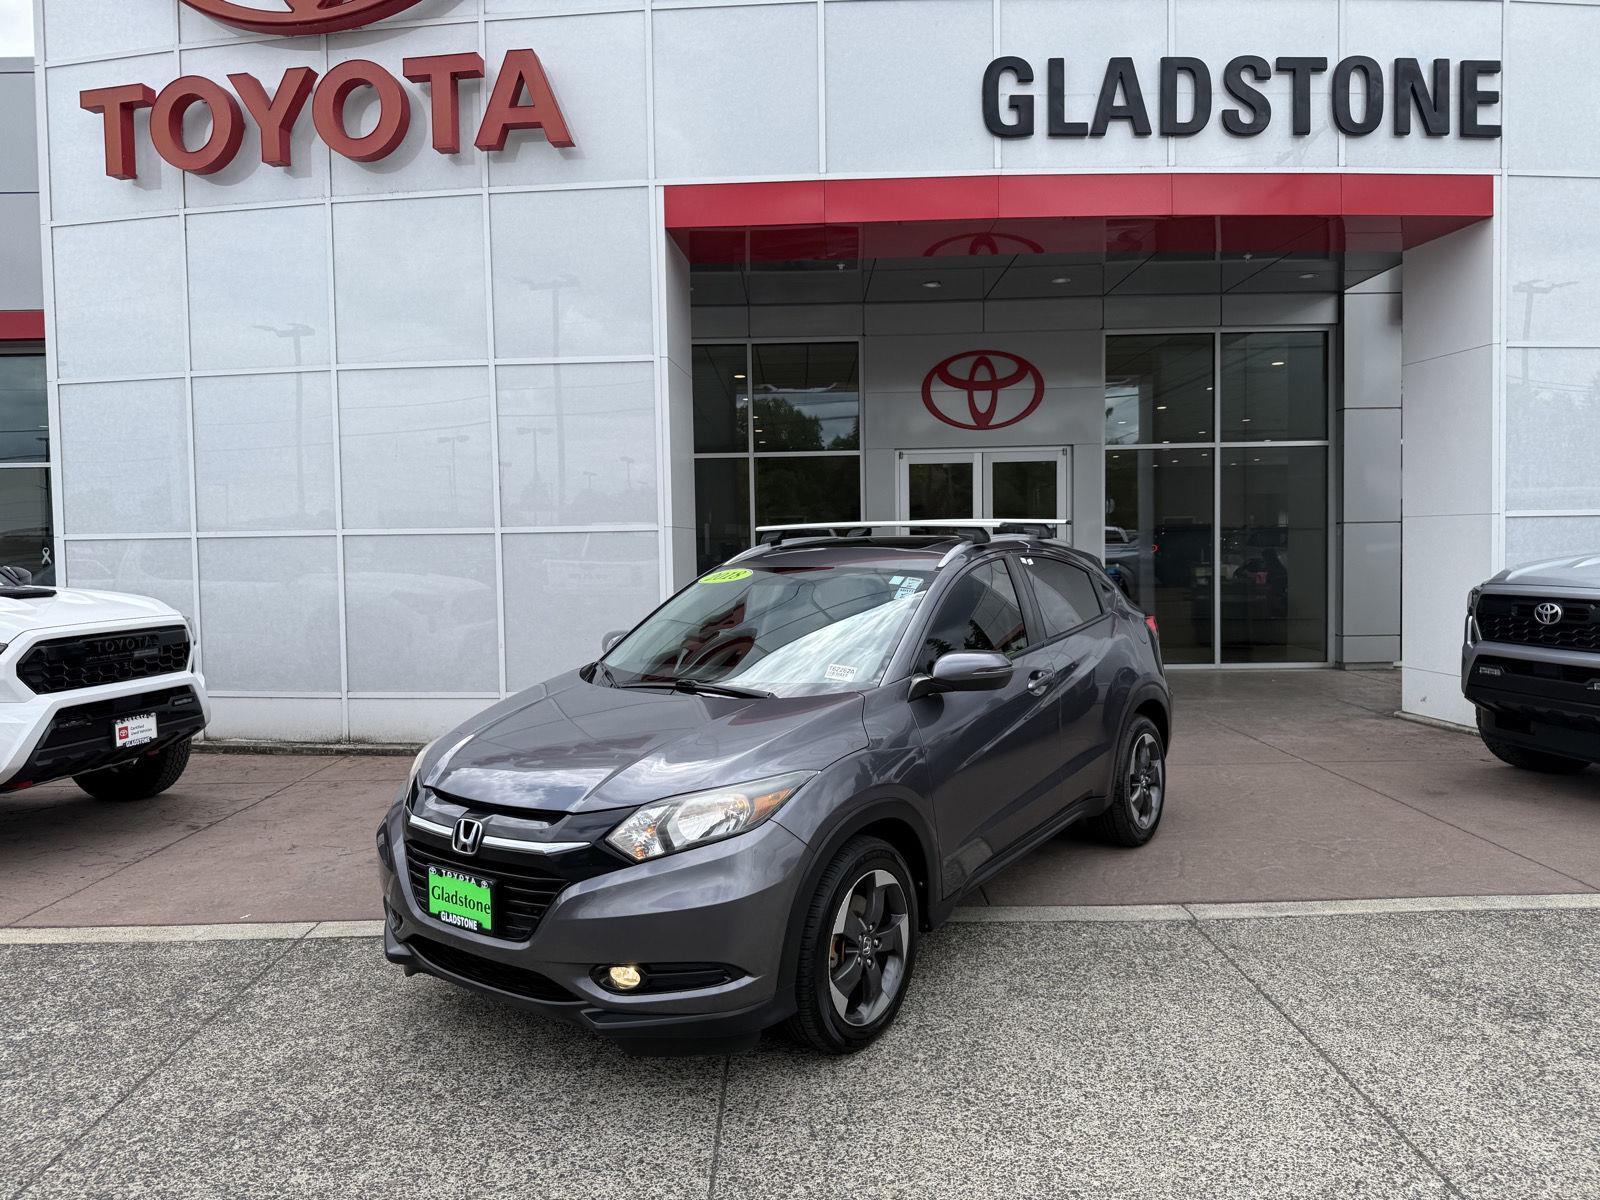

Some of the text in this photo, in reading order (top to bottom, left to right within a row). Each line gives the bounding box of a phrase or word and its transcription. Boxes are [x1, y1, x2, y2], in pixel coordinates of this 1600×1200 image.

[982, 55, 1503, 139] GLADSTONE
[79, 48, 576, 179] TOYOTA
[96, 635, 154, 653] TOYOTA
[441, 869, 476, 885] TOYOTA
[431, 885, 491, 914] Gladstone
[440, 911, 478, 931] GLADSTONE
